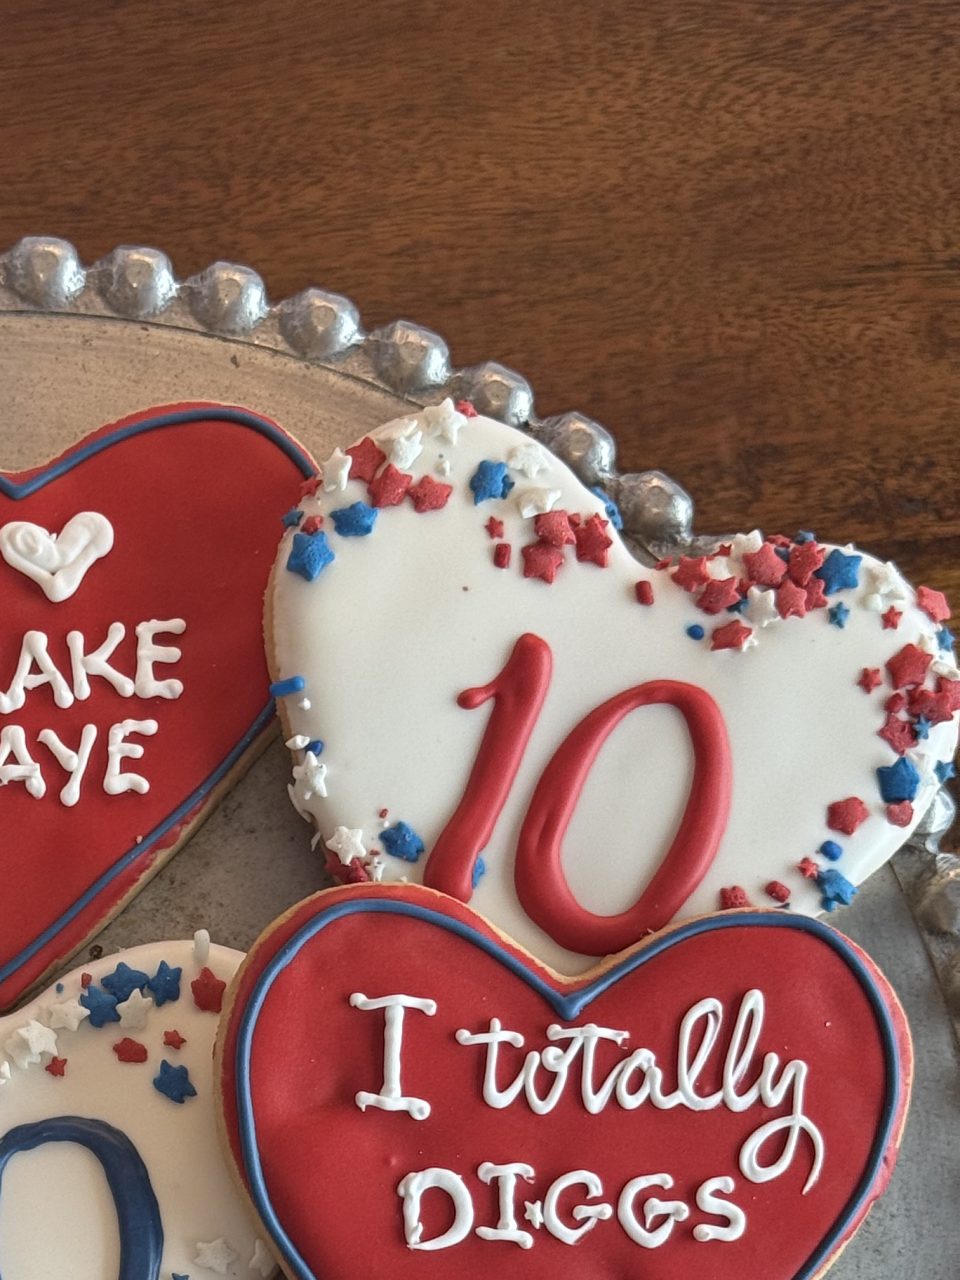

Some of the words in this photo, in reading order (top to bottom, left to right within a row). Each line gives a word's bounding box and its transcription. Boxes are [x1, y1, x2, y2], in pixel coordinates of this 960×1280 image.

[424, 632, 732, 957] 10
[349, 993, 436, 1120] I
[455, 988, 824, 1195] totally
[397, 1161, 746, 1250] DIGGS
